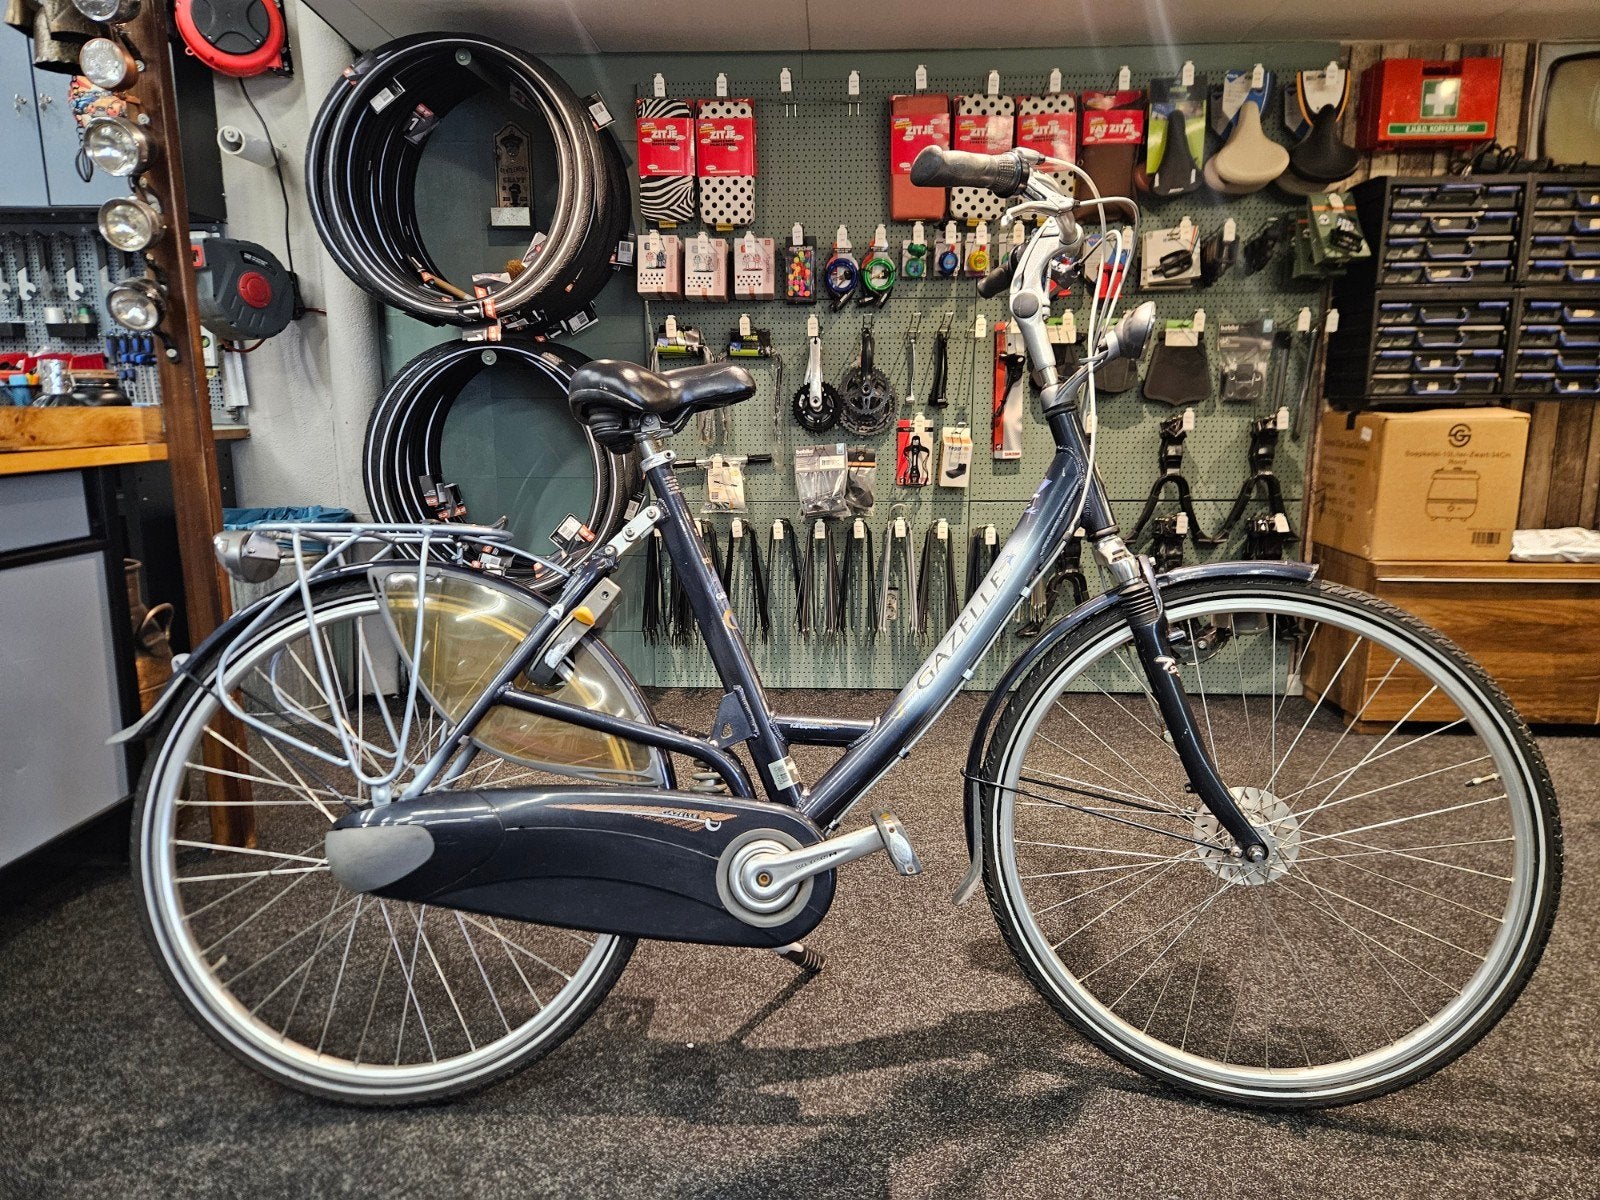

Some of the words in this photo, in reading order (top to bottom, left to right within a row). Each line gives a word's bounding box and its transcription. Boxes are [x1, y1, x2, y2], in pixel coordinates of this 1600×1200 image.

[651, 129, 678, 139] ZITJE
[710, 129, 736, 139] ZITJE
[906, 125, 934, 135] ZITJE
[916, 570, 1006, 690] GAZELLE
